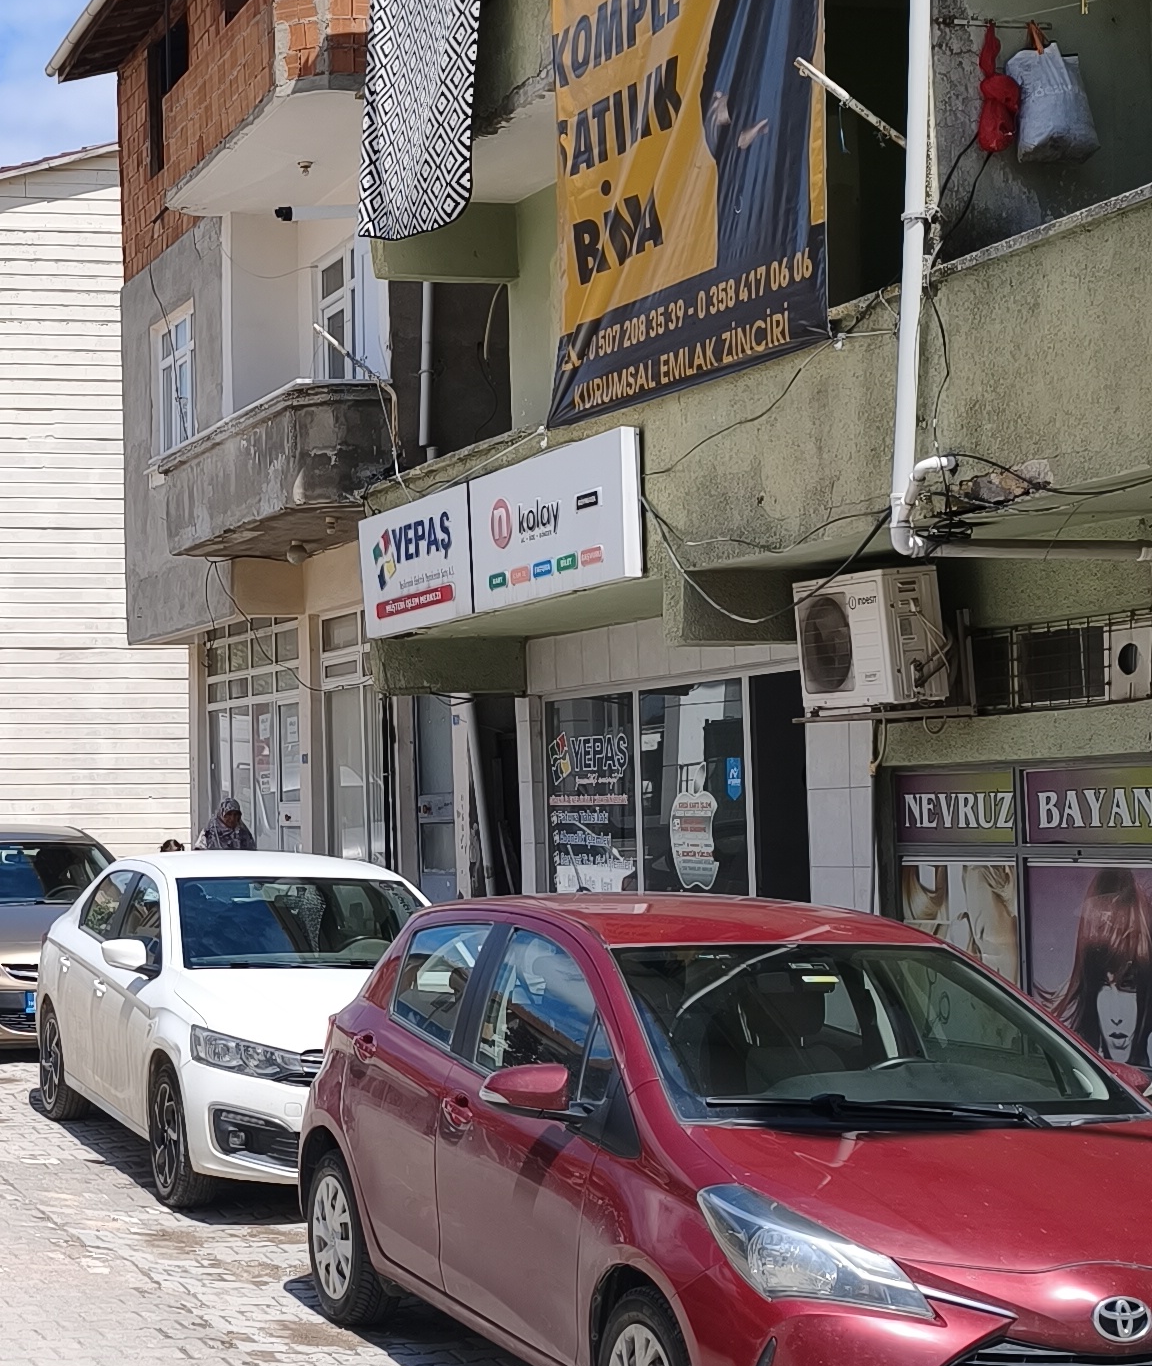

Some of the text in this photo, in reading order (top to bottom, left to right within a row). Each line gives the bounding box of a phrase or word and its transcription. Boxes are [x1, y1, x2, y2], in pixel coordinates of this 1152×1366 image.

[599, 324, 621, 356] 507
[623, 317, 647, 348] 208
[649, 307, 665, 337] 35
[668, 299, 685, 330] 39
[698, 290, 706, 319] 0
[709, 278, 735, 315] 358
[739, 264, 767, 303] 417
[770, 256, 790, 291] 06
[793, 247, 813, 282] 06
[573, 302, 791, 411] KURUMSAL EMLAK ZİNCİRİ
[391, 511, 453, 564] YEPAŞ
[518, 498, 560, 534] kolay
[570, 733, 628, 778] YEPAŞ
[903, 791, 1015, 829] NEVRUZ
